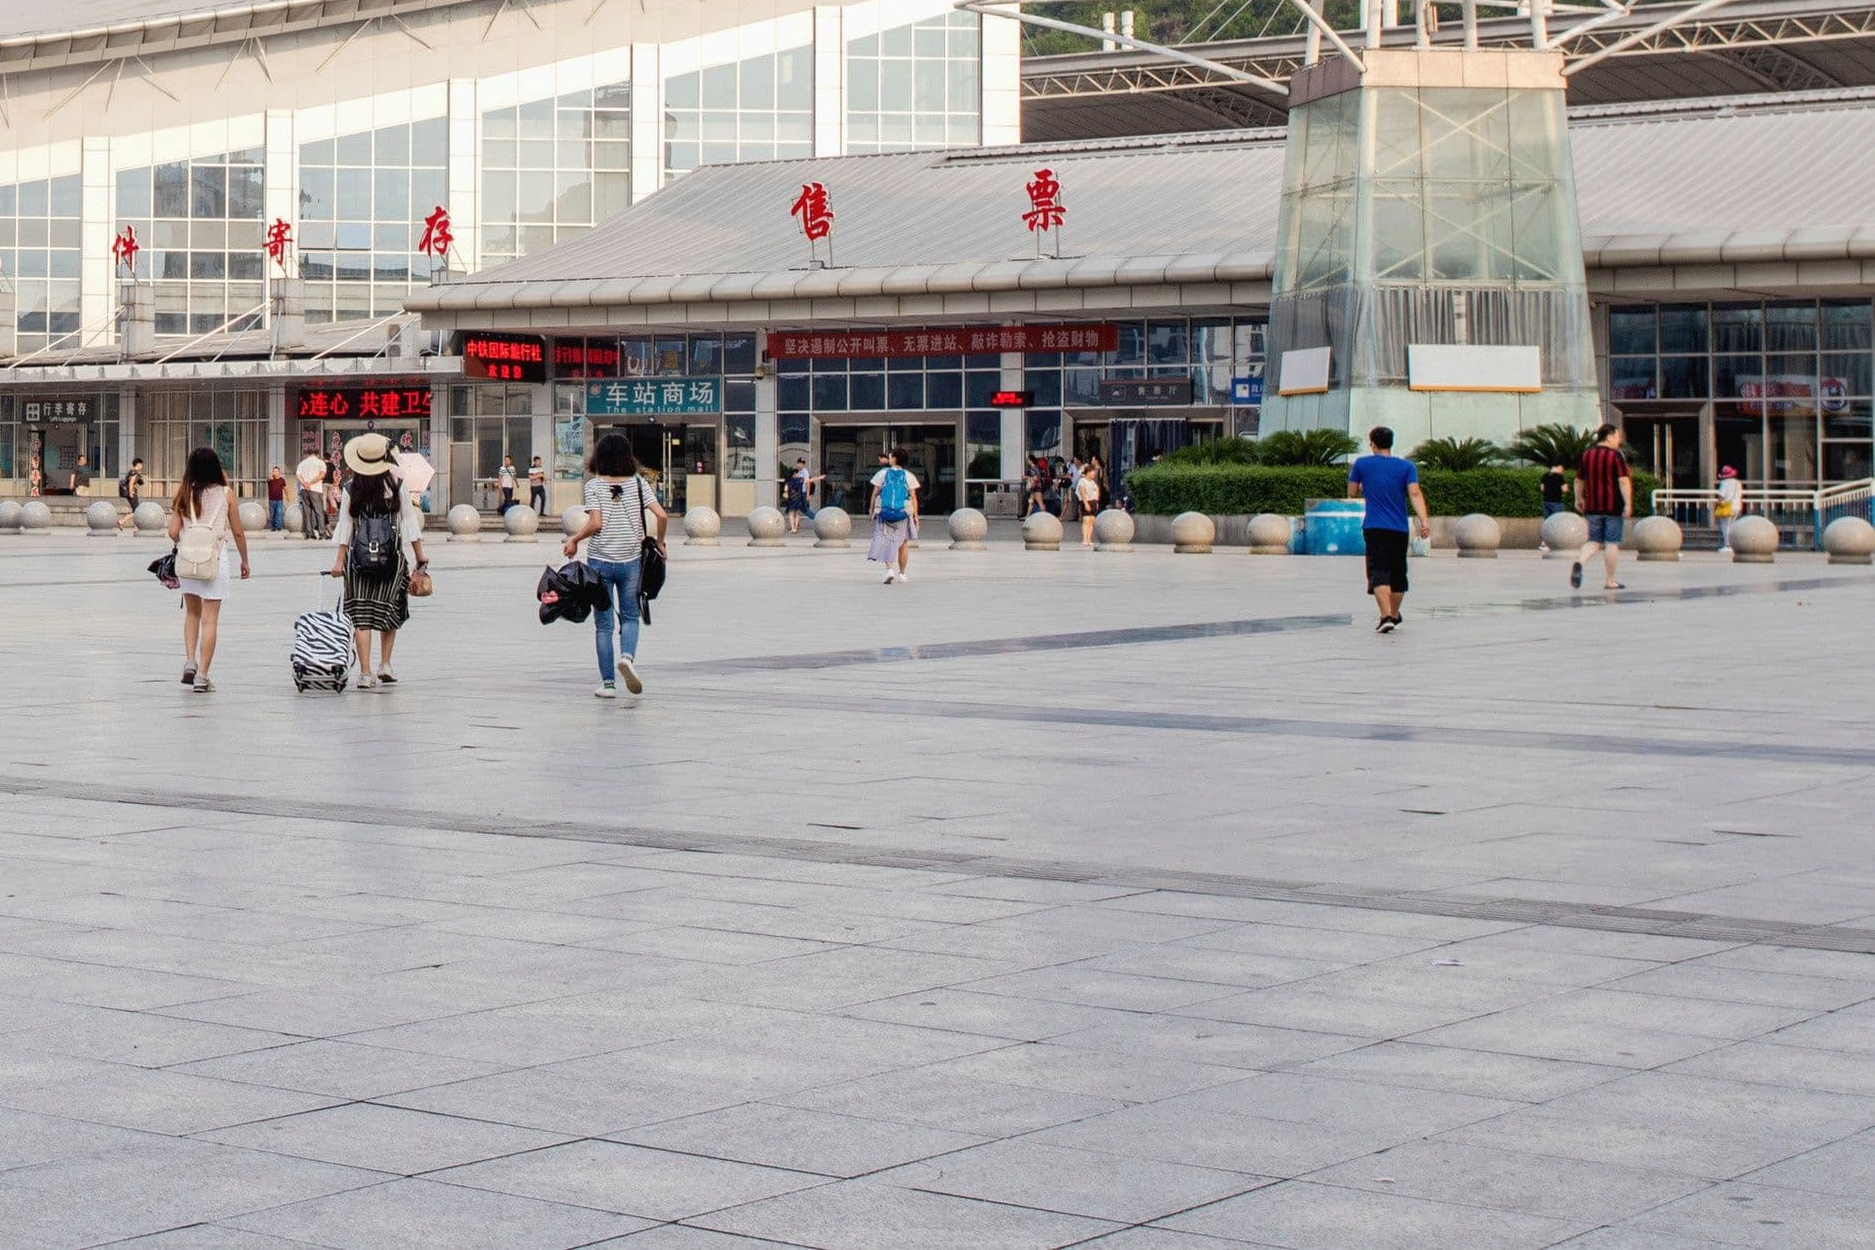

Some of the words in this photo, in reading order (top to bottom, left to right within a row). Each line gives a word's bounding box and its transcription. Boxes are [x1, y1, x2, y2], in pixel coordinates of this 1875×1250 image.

[791, 168, 1066, 241] 售票
[605, 381, 714, 407] 车站商场
